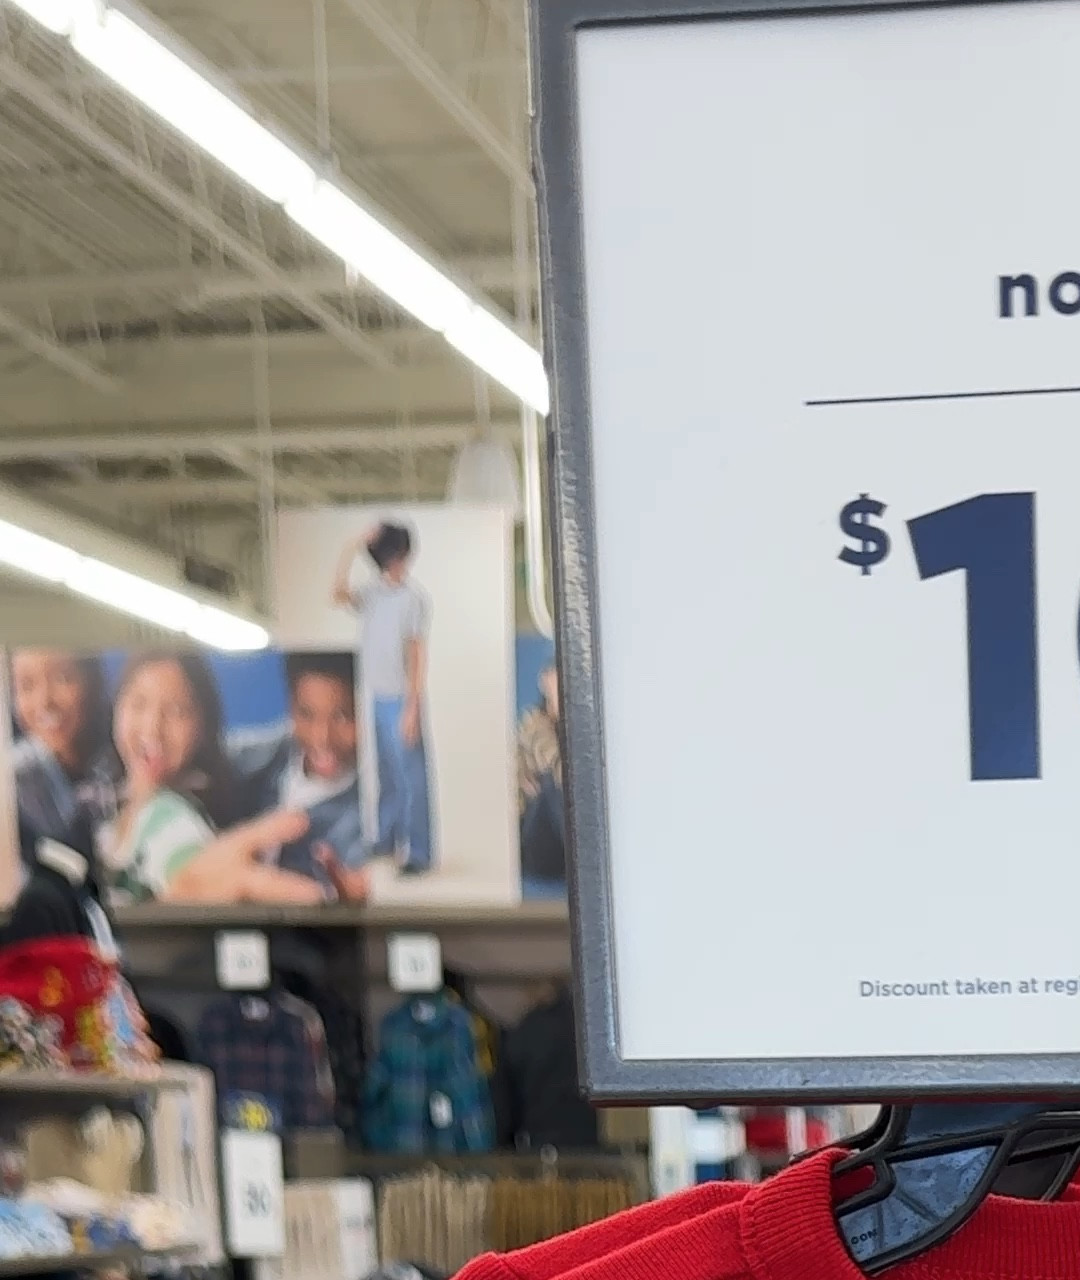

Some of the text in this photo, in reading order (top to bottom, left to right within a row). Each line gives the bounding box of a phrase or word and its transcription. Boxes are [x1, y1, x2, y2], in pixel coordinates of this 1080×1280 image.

[858, 979, 949, 998] Discount
[954, 977, 1012, 996] taken
[1018, 977, 1039, 995] at
